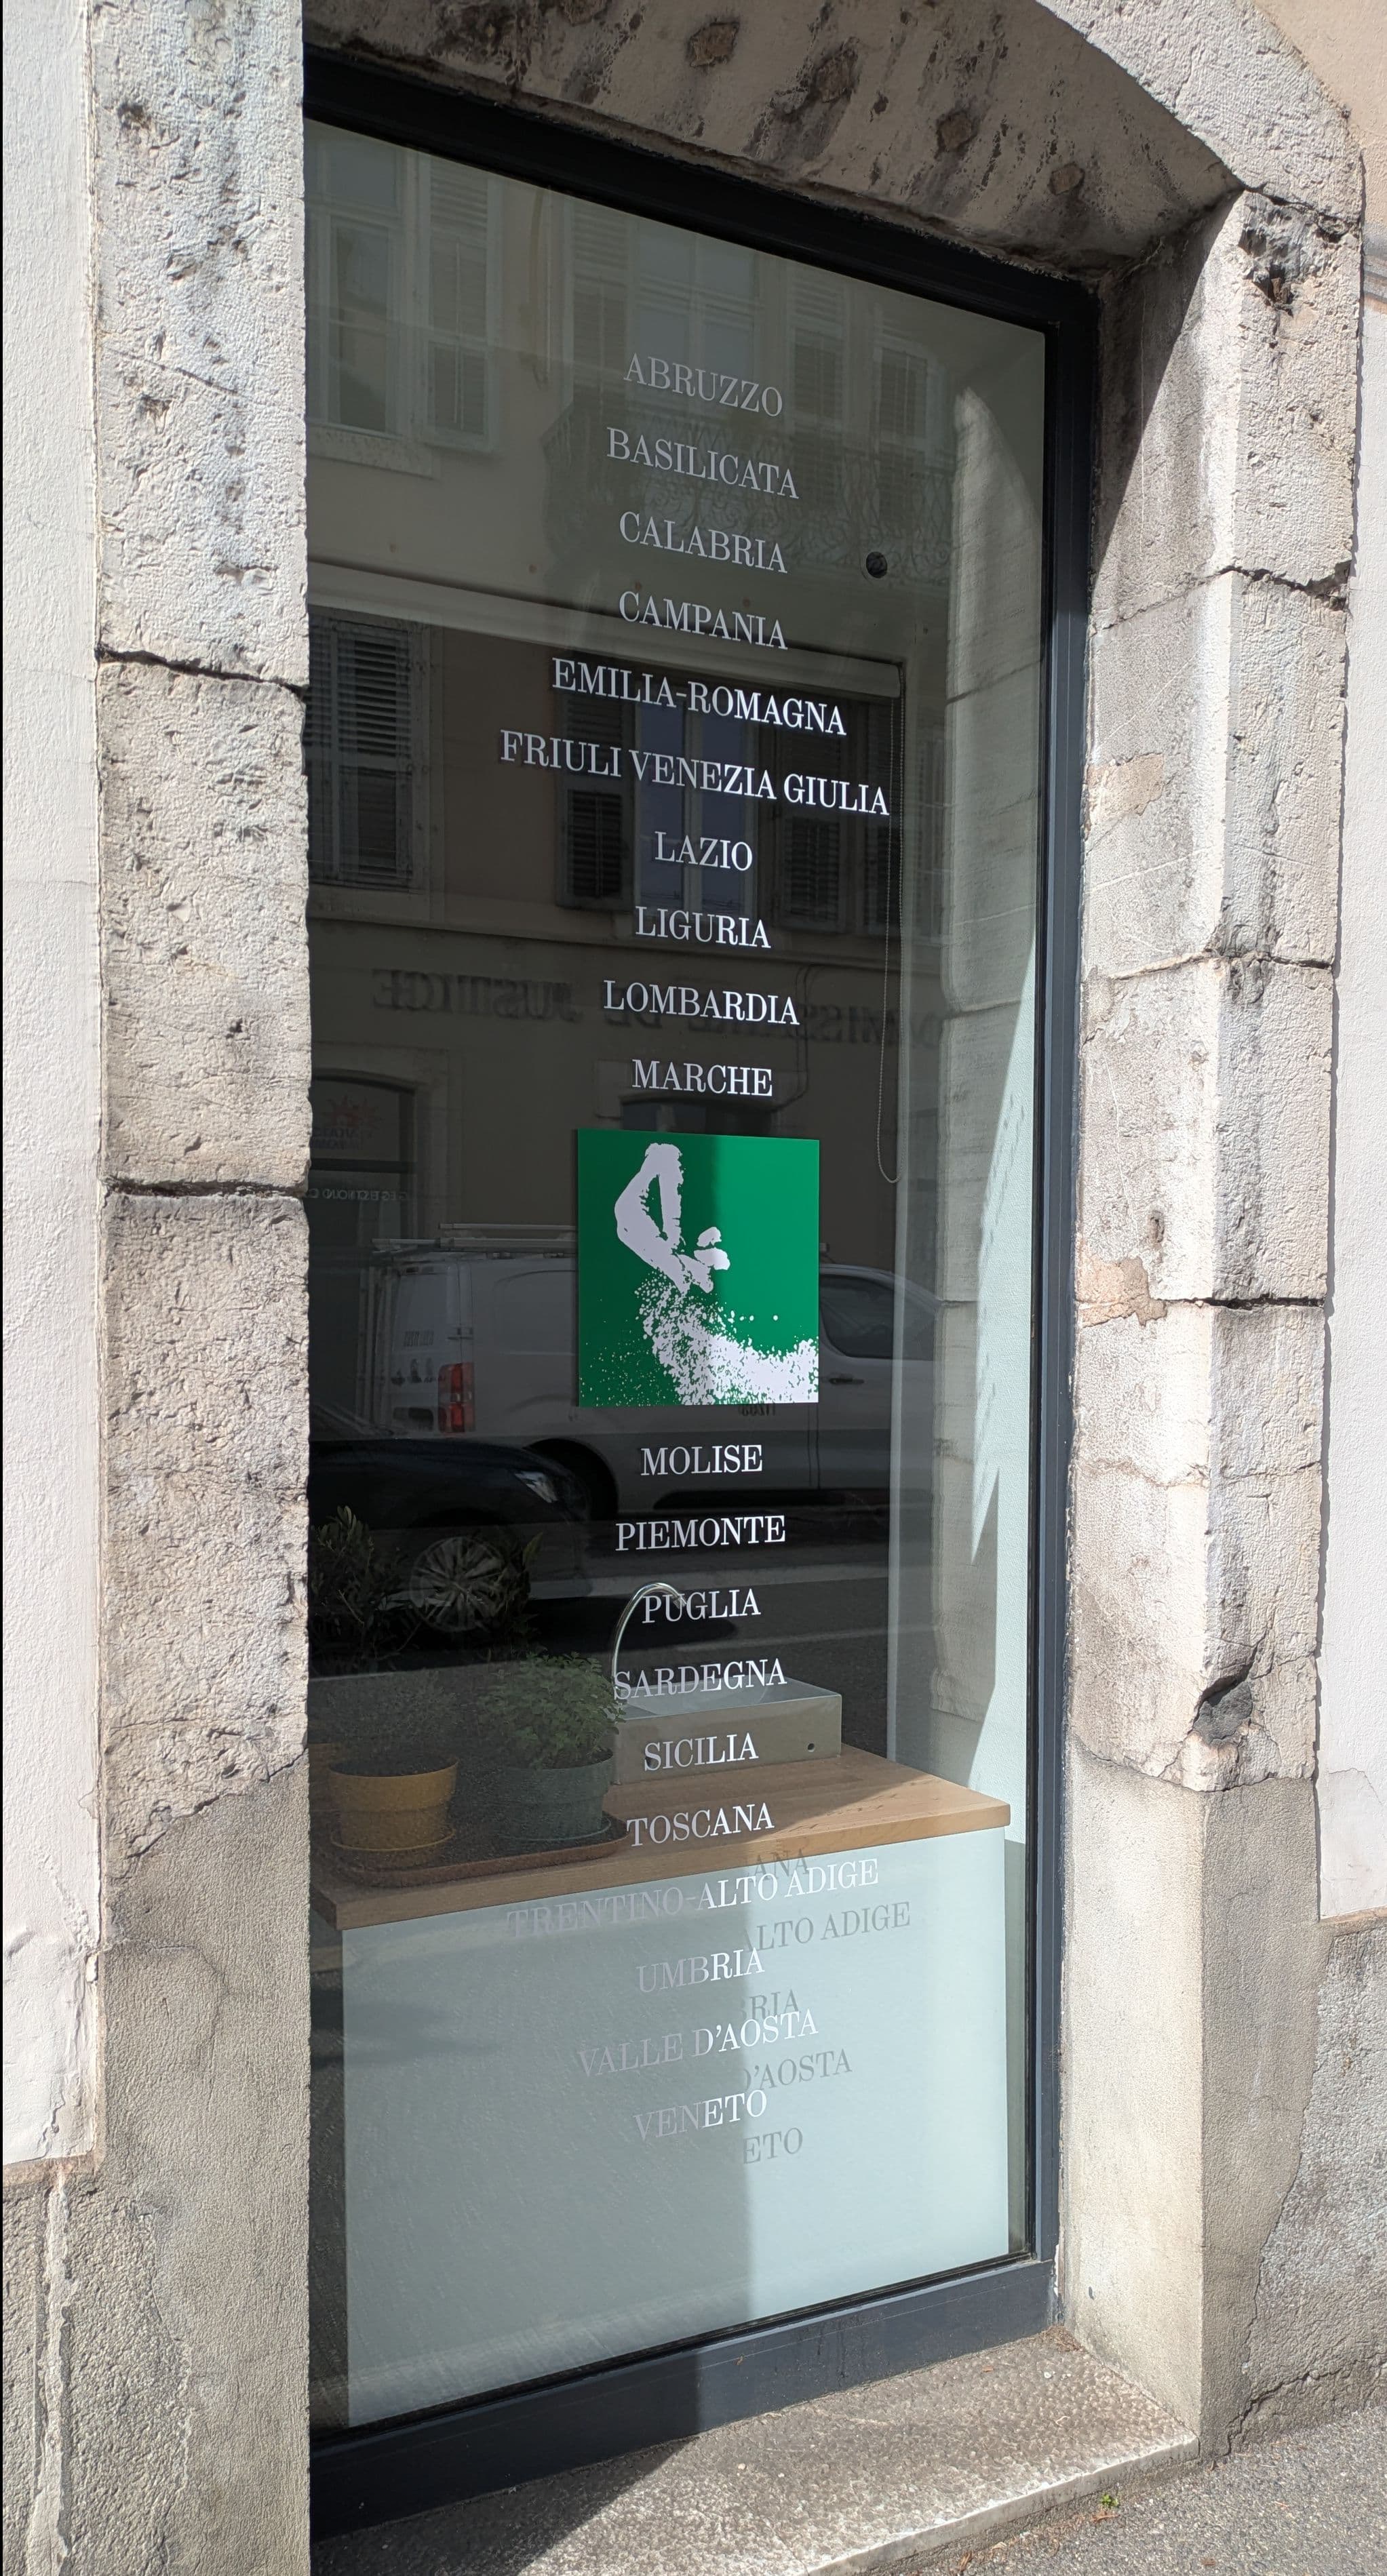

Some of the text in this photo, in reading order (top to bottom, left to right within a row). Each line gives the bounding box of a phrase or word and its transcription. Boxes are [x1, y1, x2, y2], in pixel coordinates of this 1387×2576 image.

[623, 353, 783, 416] ABRUZZO
[606, 427, 799, 499] BASILICATA
[619, 511, 787, 574] CALABRIA
[619, 591, 788, 650] CAMPANIA
[552, 657, 846, 736] EMILIA-ROMAGNA
[500, 729, 889, 816] FRIULI VENEZIA GIULIA
[655, 831, 753, 871] LAZIO
[636, 906, 771, 949] LIGURIA
[604, 980, 800, 1025] LOMBARDIA
[632, 1059, 773, 1097] MARCHE
[641, 1444, 763, 1476] MOLISE
[615, 1515, 786, 1551] PIEMONTE
[642, 1588, 761, 1623] PUGLIA
[614, 1657, 787, 1701] SARDEGNA
[644, 1732, 758, 1772] SICILIA
[626, 1802, 775, 1847] TOSCANA
[507, 1858, 878, 1939] TRENTINO-ALTO ADIGE
[636, 1947, 764, 1994] UMBRIA
[578, 2033, 683, 2078] VALLE
[633, 2088, 767, 2142] VENETO
